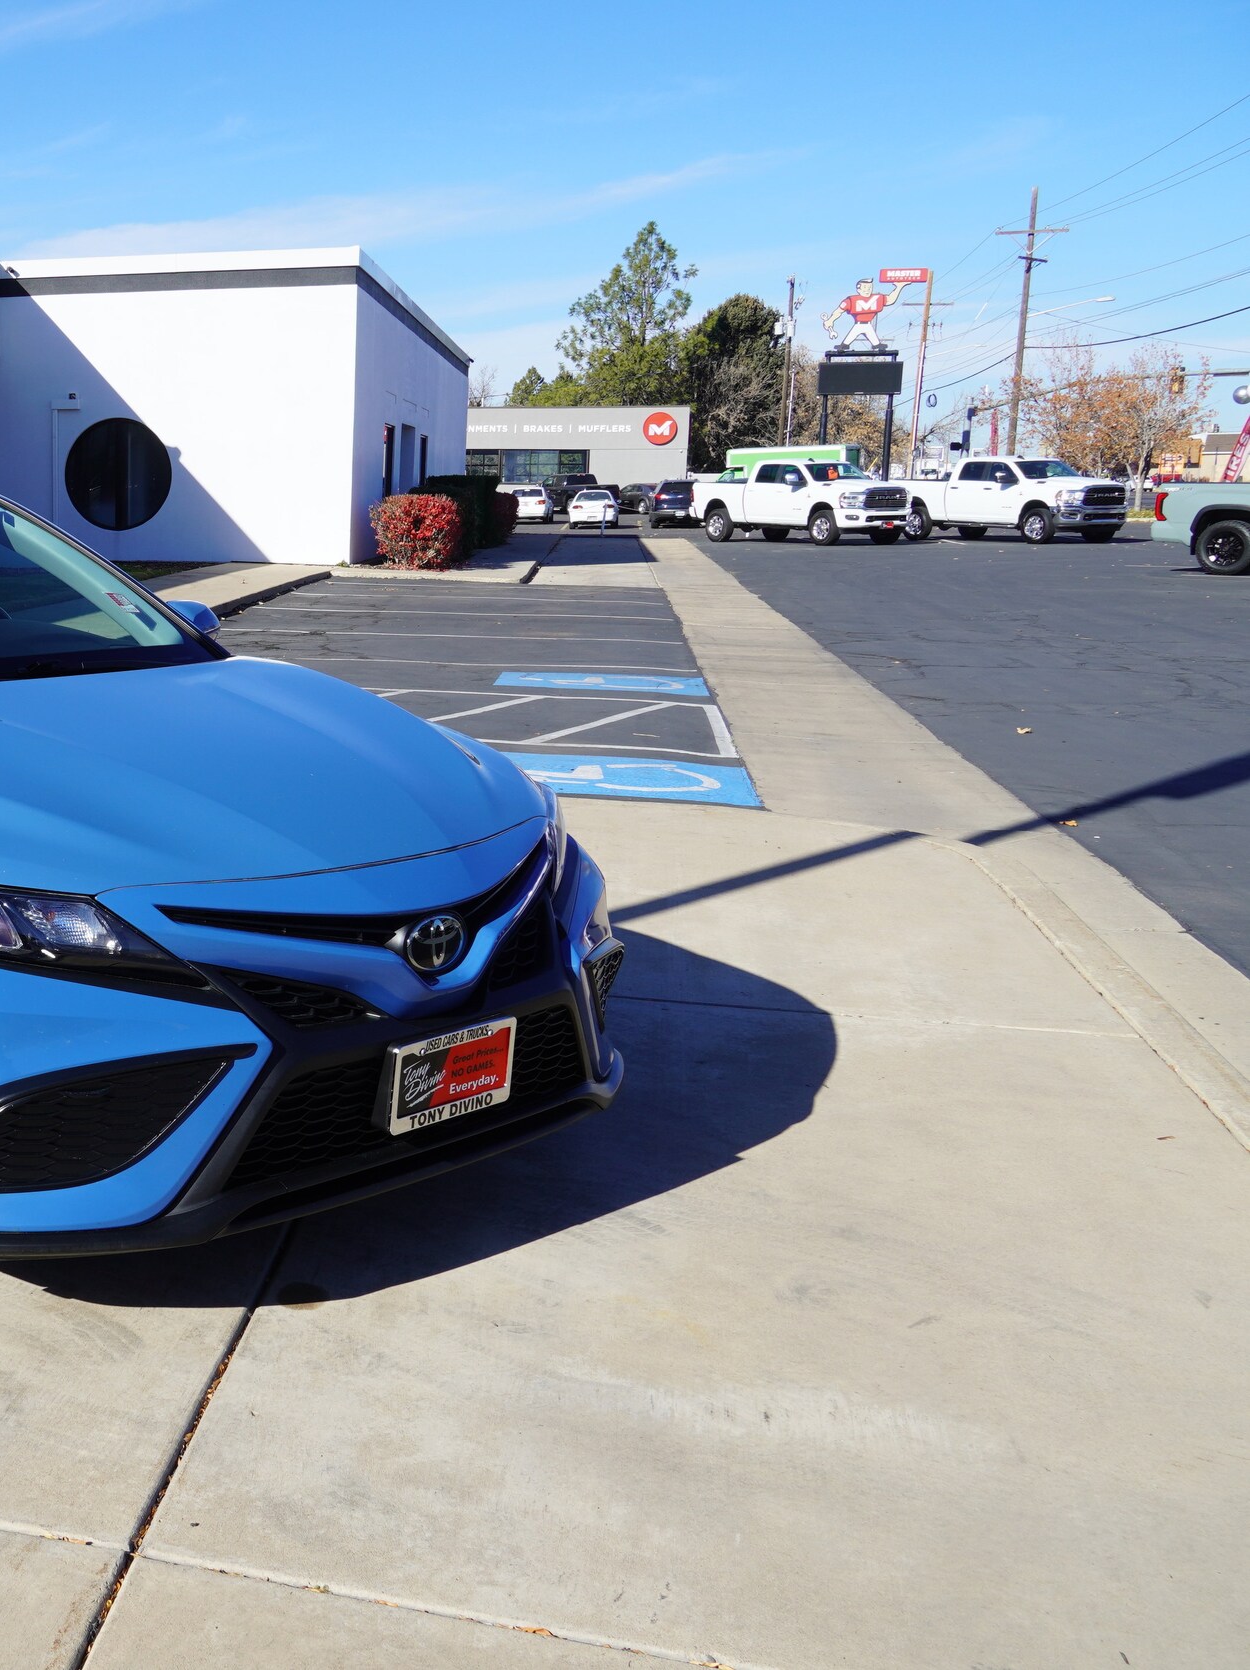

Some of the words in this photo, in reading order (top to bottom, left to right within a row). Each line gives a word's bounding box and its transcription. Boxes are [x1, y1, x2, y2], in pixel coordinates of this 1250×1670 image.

[467, 424, 508, 433] NMENTS
[523, 424, 563, 433] BRAKES
[578, 424, 632, 433] MUFFLERS
[1224, 432, 1250, 482] IRES
[425, 1040, 442, 1052] USED
[442, 1034, 459, 1048] CARS
[459, 1032, 465, 1043] &
[466, 1025, 489, 1041] TRUCKS
[451, 1067, 464, 1078] NO
[466, 1061, 495, 1074] GAMES.
[453, 1053, 475, 1065] Great
[403, 1060, 431, 1085] Tony
[449, 1074, 499, 1095] Everyday.
[404, 1070, 446, 1101] Divino
[409, 1106, 445, 1129] TONY
[450, 1093, 493, 1116] DIVINO
